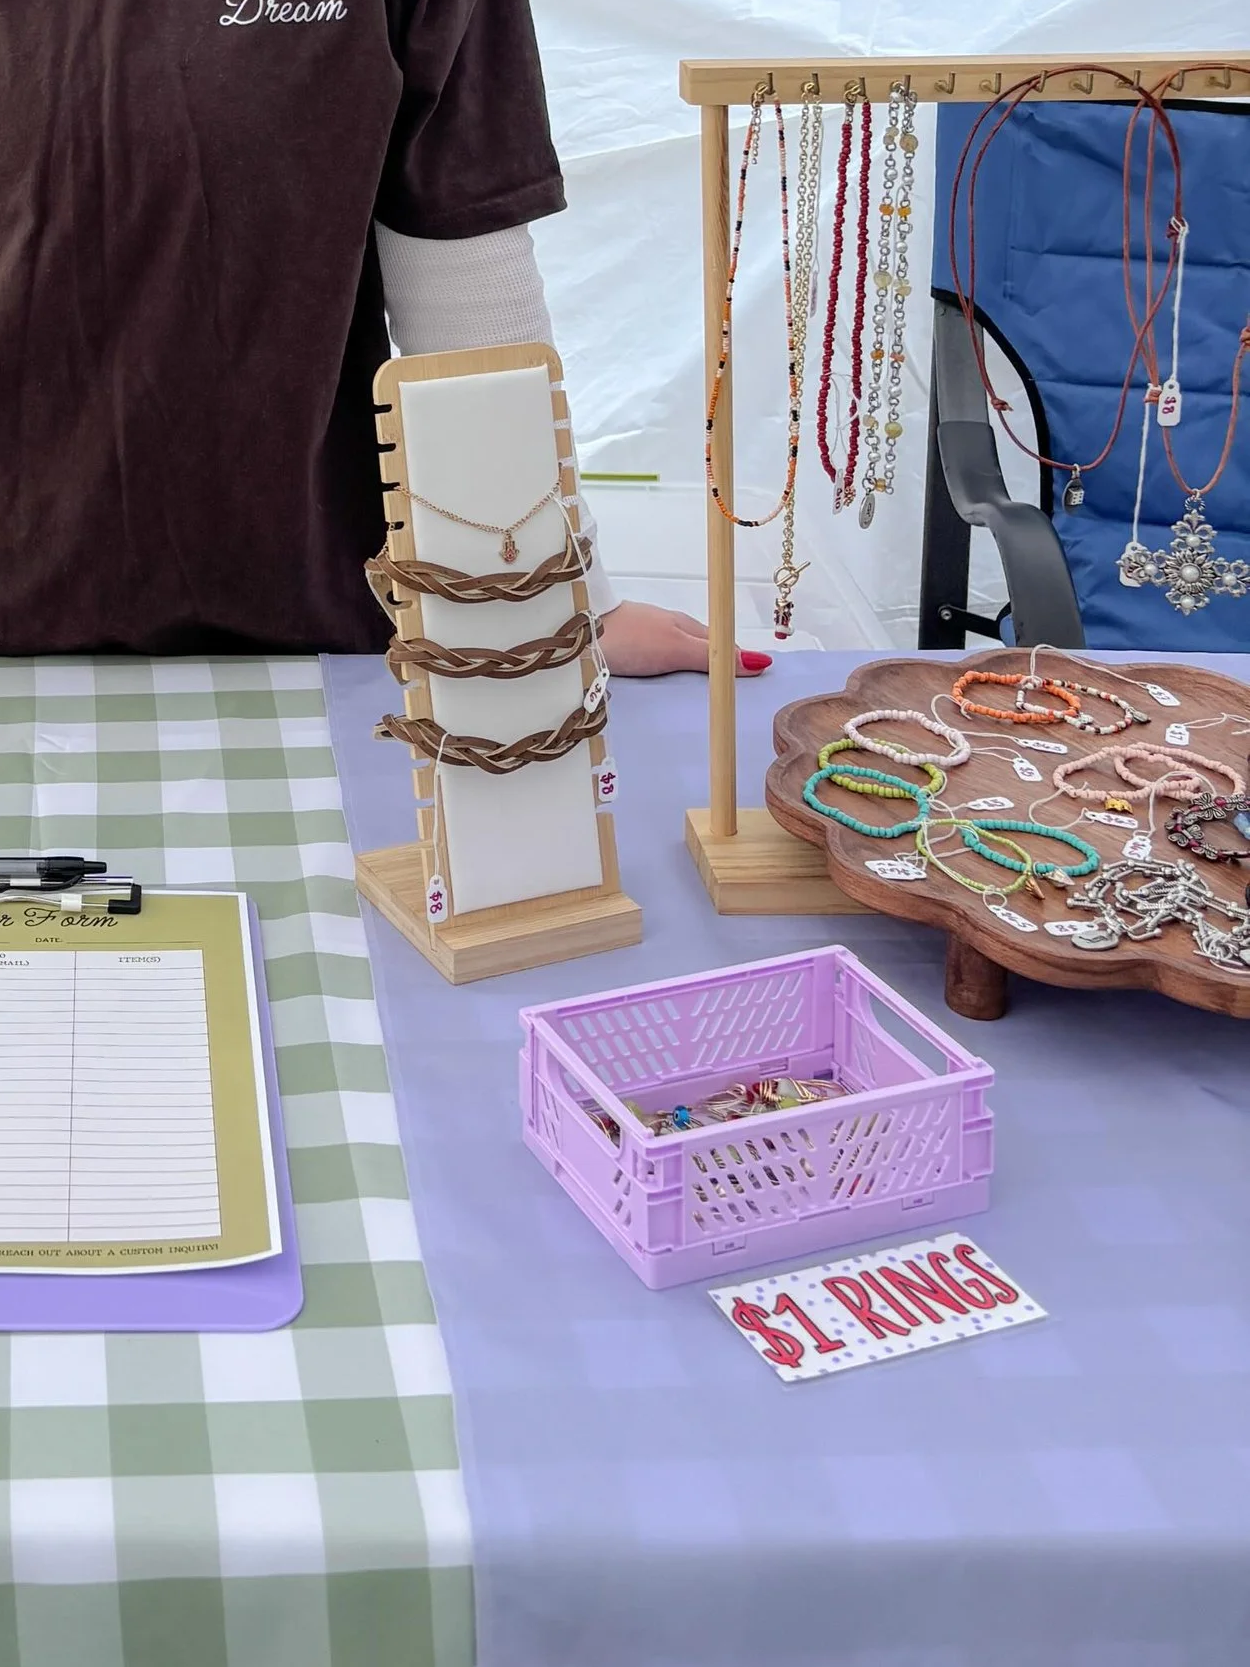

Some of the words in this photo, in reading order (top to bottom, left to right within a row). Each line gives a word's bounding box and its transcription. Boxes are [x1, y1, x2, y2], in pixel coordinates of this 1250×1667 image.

[599, 772, 616, 795] $8
[429, 890, 443, 914] $8
[23, 907, 119, 928] Form
[38, 1249, 61, 1257] OUT
[65, 1249, 102, 1257] ABOUT
[119, 1247, 163, 1256] CUSTOM
[731, 1292, 846, 1368] $1
[821, 1243, 1020, 1340] RINGS
